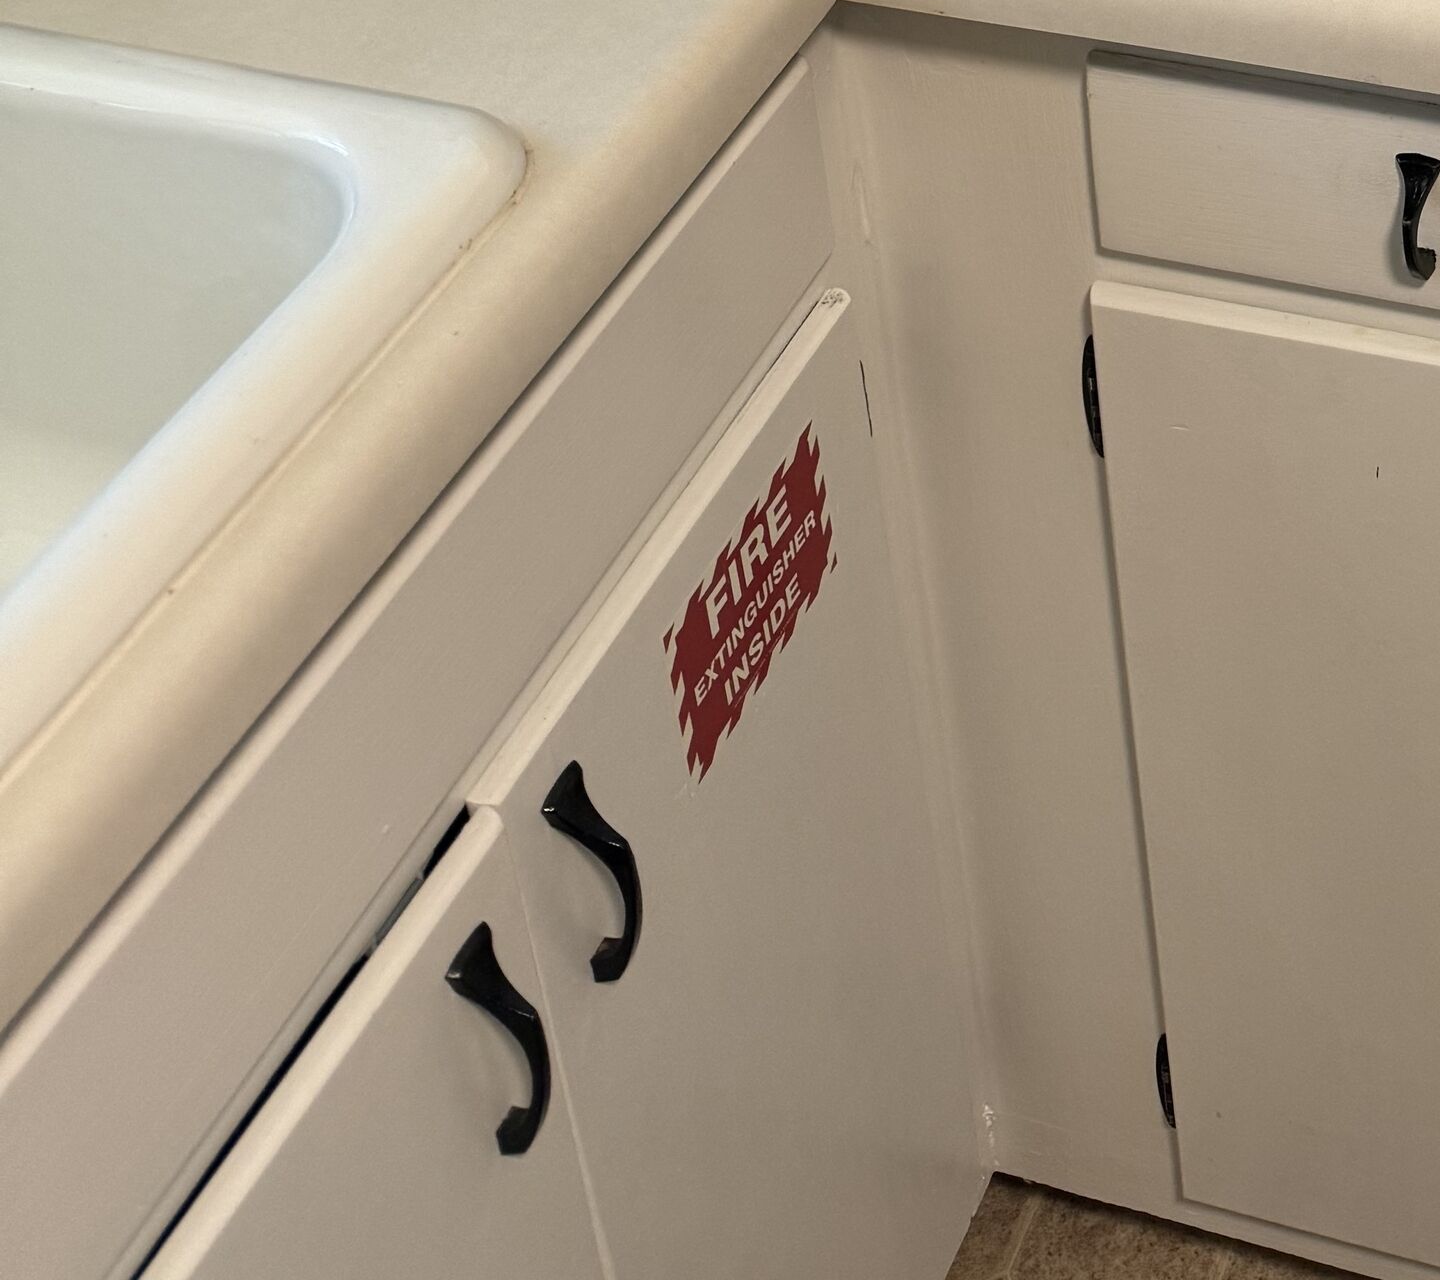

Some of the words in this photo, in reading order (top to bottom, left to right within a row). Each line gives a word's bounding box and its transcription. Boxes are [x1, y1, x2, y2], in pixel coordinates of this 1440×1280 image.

[693, 509, 817, 707] EXTINGUISHER
[706, 483, 792, 640] FIRE
[724, 572, 802, 706] INSIDE
